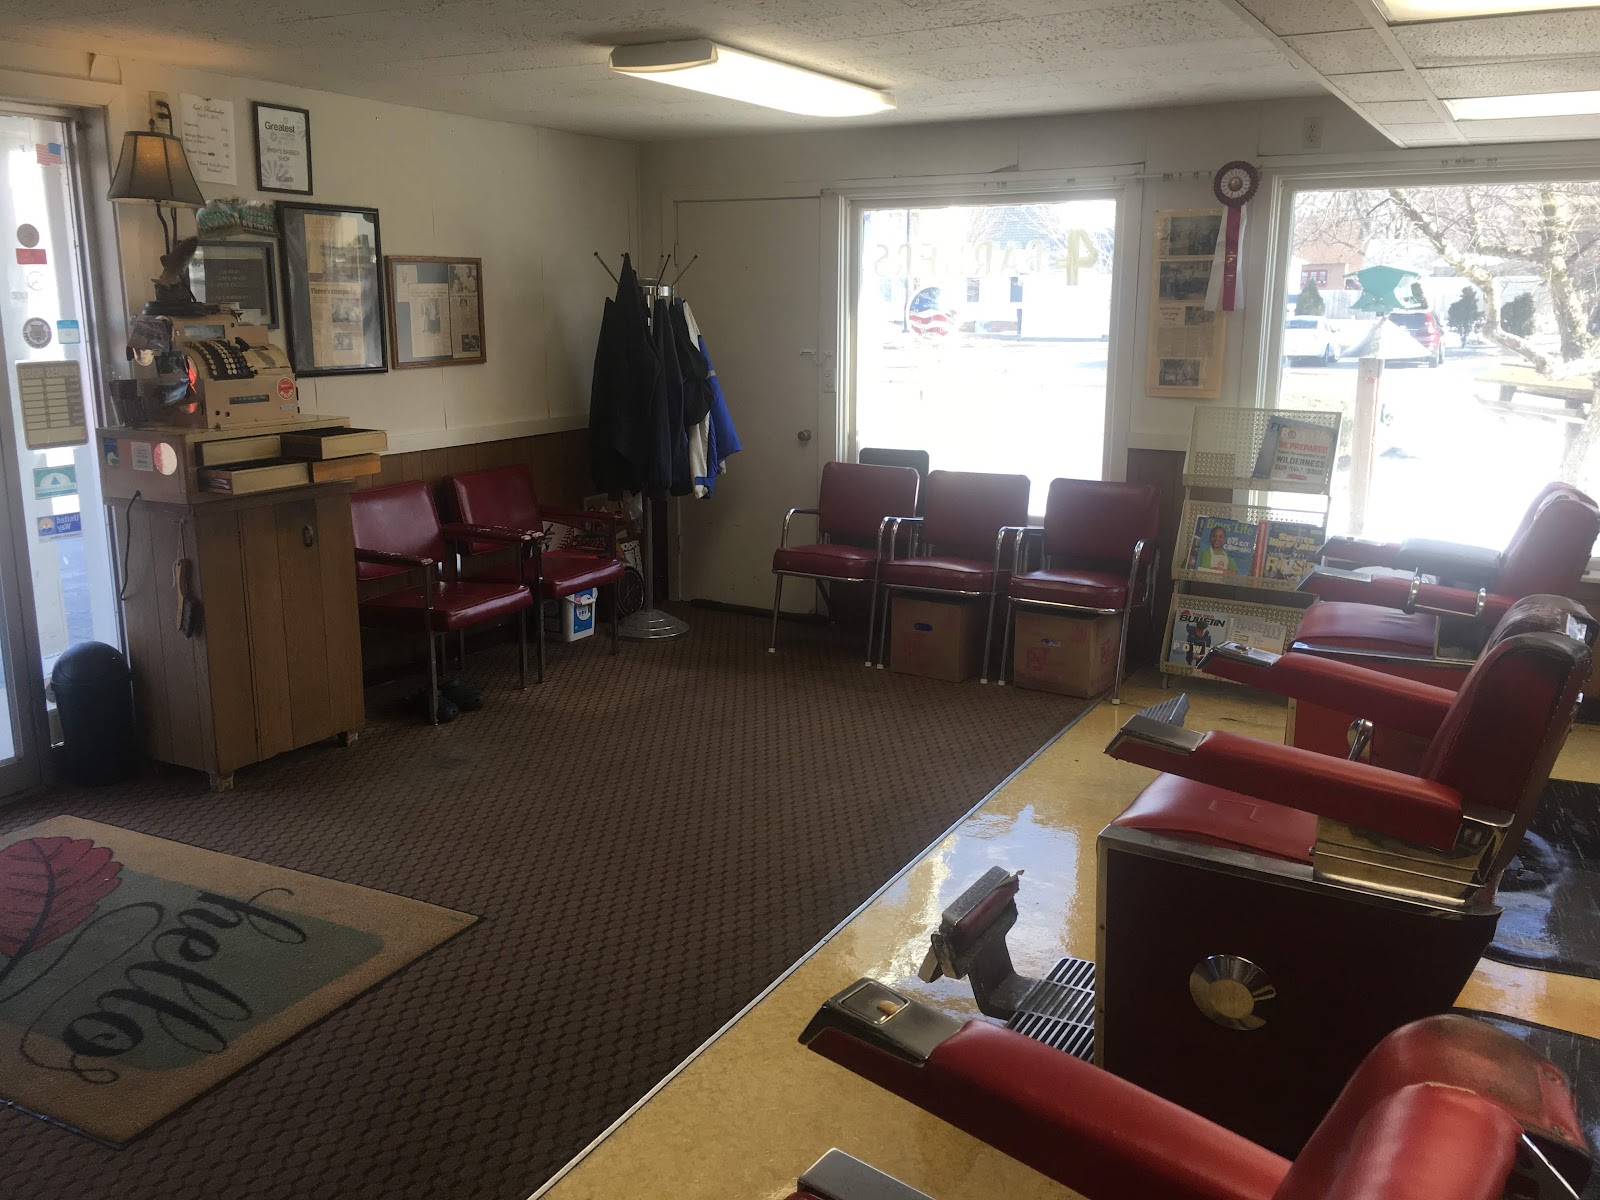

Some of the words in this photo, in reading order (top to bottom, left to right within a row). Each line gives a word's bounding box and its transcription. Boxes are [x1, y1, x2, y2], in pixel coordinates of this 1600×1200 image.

[264, 120, 296, 134] Greatest
[1279, 441, 1289, 449] BE
[1290, 442, 1328, 453] PREPARED
[1274, 464, 1303, 472] SURVIVA
[1276, 455, 1325, 468] WILDERNESS
[1234, 523, 1254, 536] Life
[1180, 614, 1226, 628] BULLETIN
[50, 886, 307, 1078] hello
